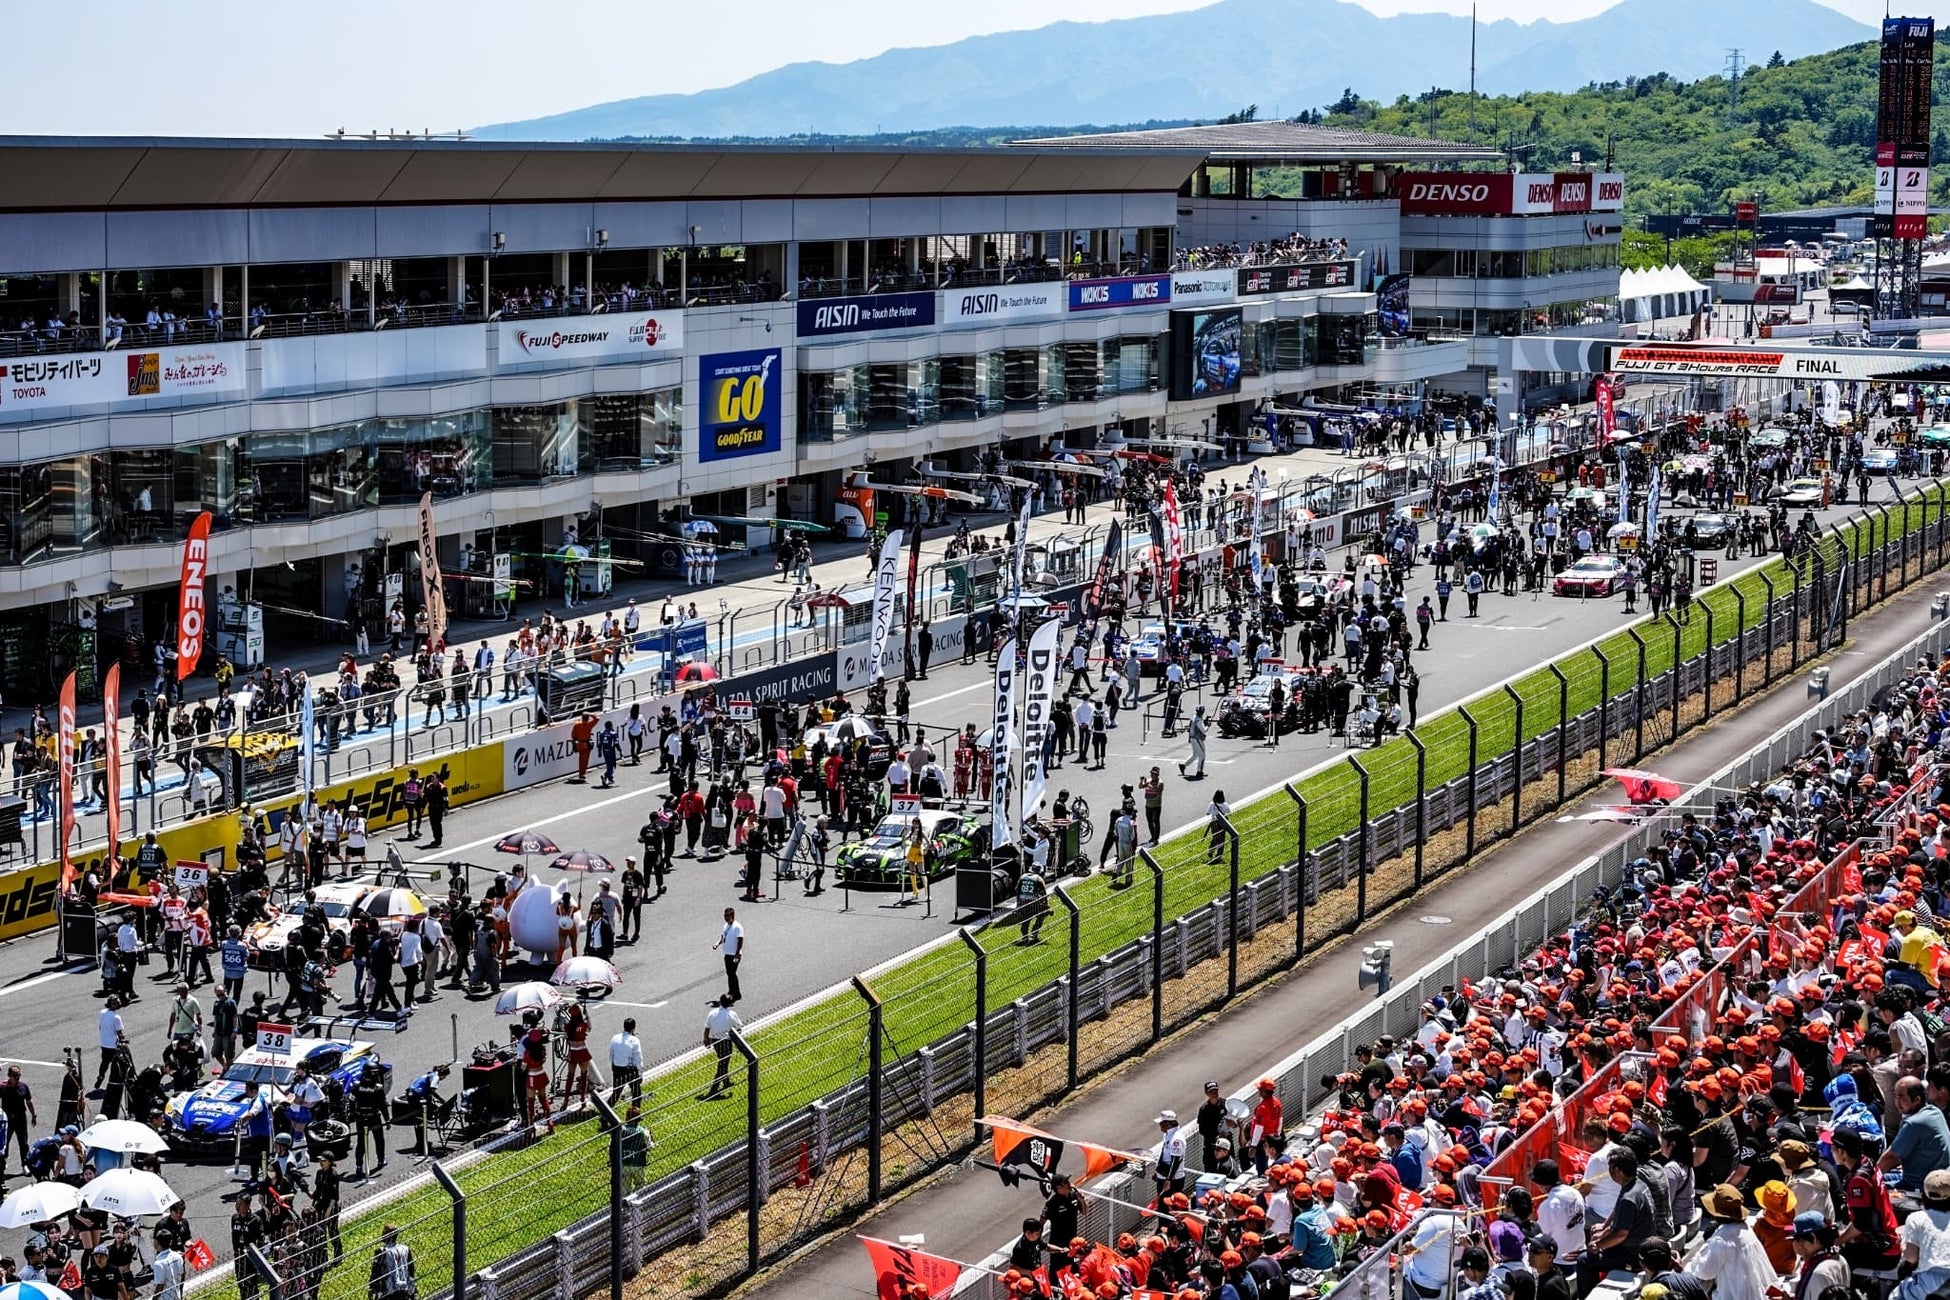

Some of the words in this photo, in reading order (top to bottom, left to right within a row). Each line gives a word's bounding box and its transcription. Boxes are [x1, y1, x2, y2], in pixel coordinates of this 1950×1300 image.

[1909, 26, 1928, 37] FUJI
[1409, 184, 1489, 201] DENSO
[1527, 184, 1554, 203] DENSO
[1561, 182, 1586, 202] DENSO
[1599, 182, 1622, 200] DENSO
[1247, 279, 1258, 290] GR
[1287, 276, 1298, 287] GR
[1326, 273, 1336, 284] GR
[1174, 280, 1202, 295] Panasonic
[961, 293, 998, 316] AISIN
[1000, 297, 1008, 307] We
[1008, 297, 1022, 307] Touch
[1022, 296, 1031, 306] the
[1031, 295, 1048, 305] Future
[815, 304, 859, 328] AISIN
[861, 309, 871, 319] We
[872, 308, 888, 319] Touch
[889, 307, 898, 318] the
[899, 306, 917, 317] Future
[528, 336, 550, 347] FUJI
[551, 331, 609, 349] SPEEDWAY
[11, 358, 101, 383] モビリティパーツ
[1615, 361, 1651, 369] FUJI
[1654, 362, 1676, 370] GT
[1735, 364, 1780, 374] RACE
[1796, 359, 1842, 374] FINAL
[12, 387, 46, 399] TOYOTA
[718, 375, 765, 423] GO
[717, 428, 763, 447] GOODYEAR
[842, 490, 858, 498] au
[421, 509, 434, 569] ENEOS
[425, 570, 440, 597] X
[181, 539, 205, 658] ENEOS
[870, 557, 896, 675] KENWOOD
[1266, 664, 1279, 672] 16
[755, 678, 788, 705] SPIRIT
[791, 667, 831, 692] RACING
[734, 707, 749, 717] 64
[1024, 649, 1050, 781] Deloitte
[994, 669, 1011, 806] Deloitte
[534, 735, 582, 767] MAZD
[451, 781, 470, 796] weds
[897, 801, 915, 812] 37
[142, 853, 155, 861] 021
[181, 868, 202, 880] 36
[224, 954, 242, 964] 566
[263, 1032, 285, 1047] 38
[255, 1057, 287, 1066] BOSCH
